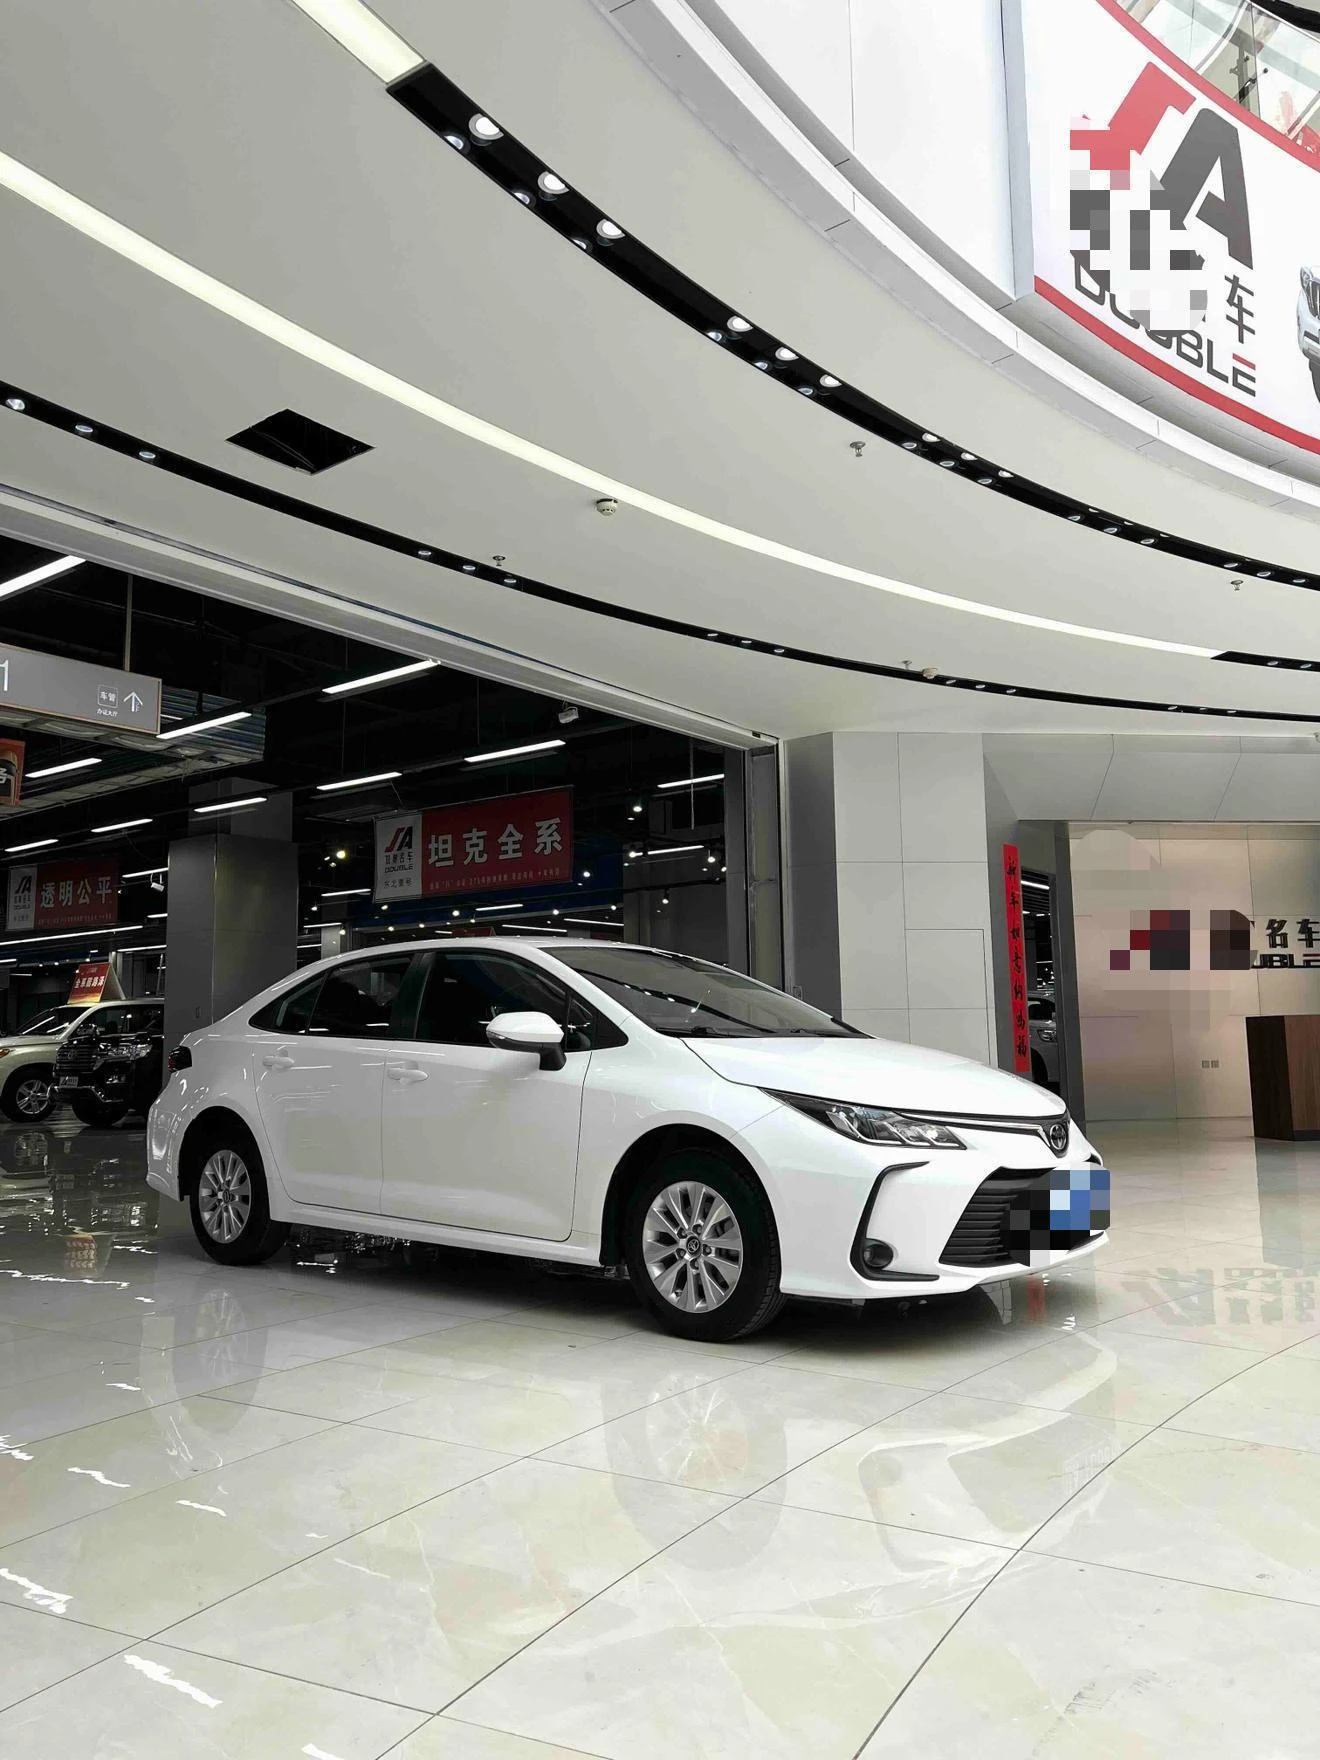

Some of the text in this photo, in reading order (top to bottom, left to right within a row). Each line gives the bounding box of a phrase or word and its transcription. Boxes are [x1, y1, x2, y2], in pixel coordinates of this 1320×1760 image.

[429, 817, 562, 867] 坦克全系
[40, 876, 113, 909] 透明公平
